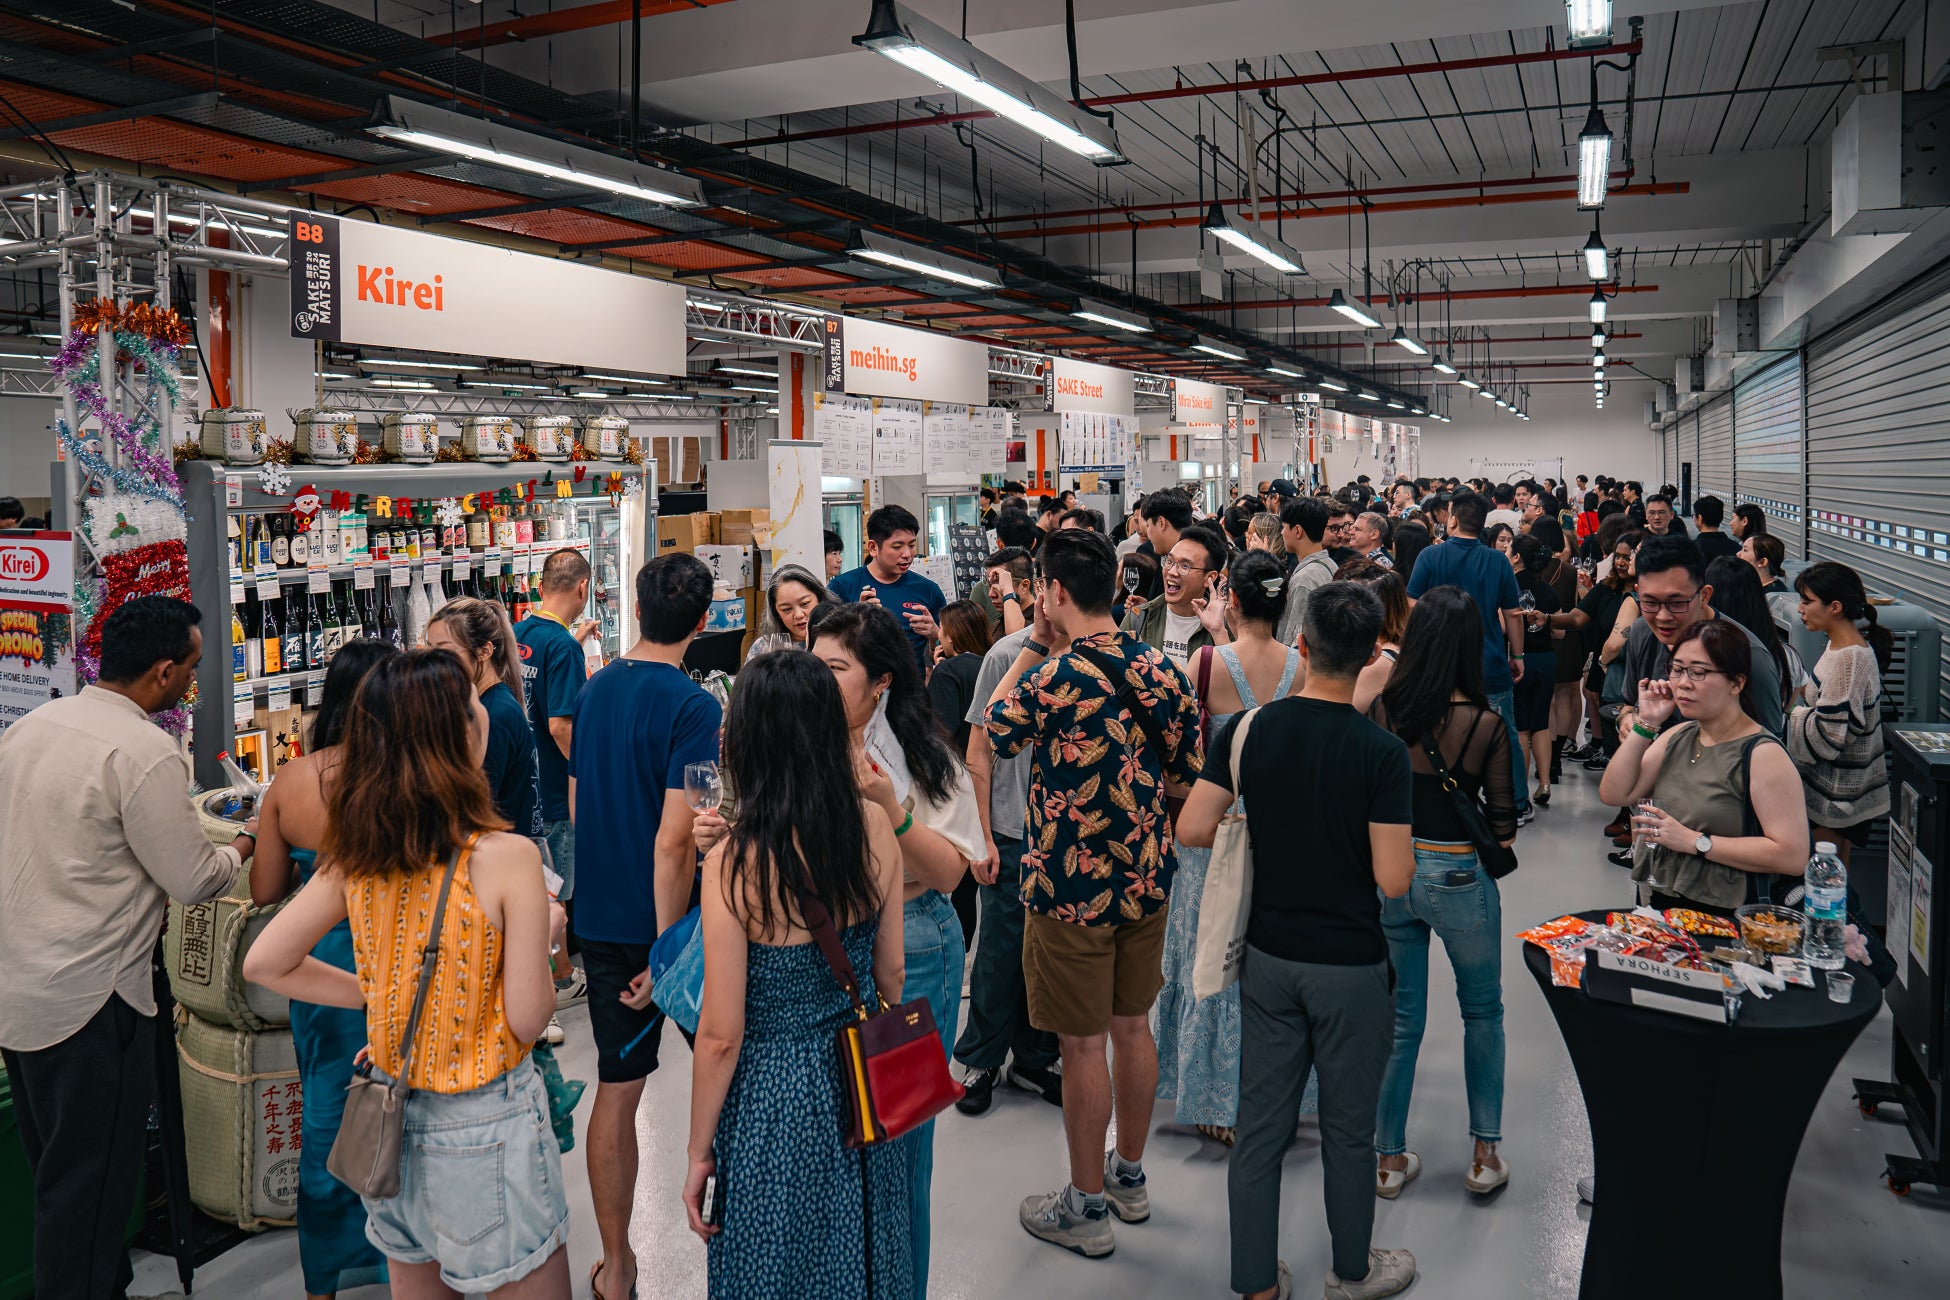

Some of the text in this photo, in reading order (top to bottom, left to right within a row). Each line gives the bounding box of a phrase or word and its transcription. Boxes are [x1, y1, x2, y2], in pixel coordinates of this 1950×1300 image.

[296, 221, 324, 244] B8
[318, 253, 331, 324] MATSURI
[357, 264, 444, 311] Kirei
[307, 280, 319, 323] SAKE
[826, 320, 838, 333] B7
[850, 345, 917, 382] meihin.sg
[1057, 377, 1079, 396] SAKE
[1080, 380, 1103, 398] Street
[330, 489, 433, 524] MERRY
[2, 553, 35, 575] Kirei
[1, 610, 39, 635] SPECIAL
[3, 671, 50, 687] HOME DELIVERY
[1616, 956, 1690, 981] SEPHORA
